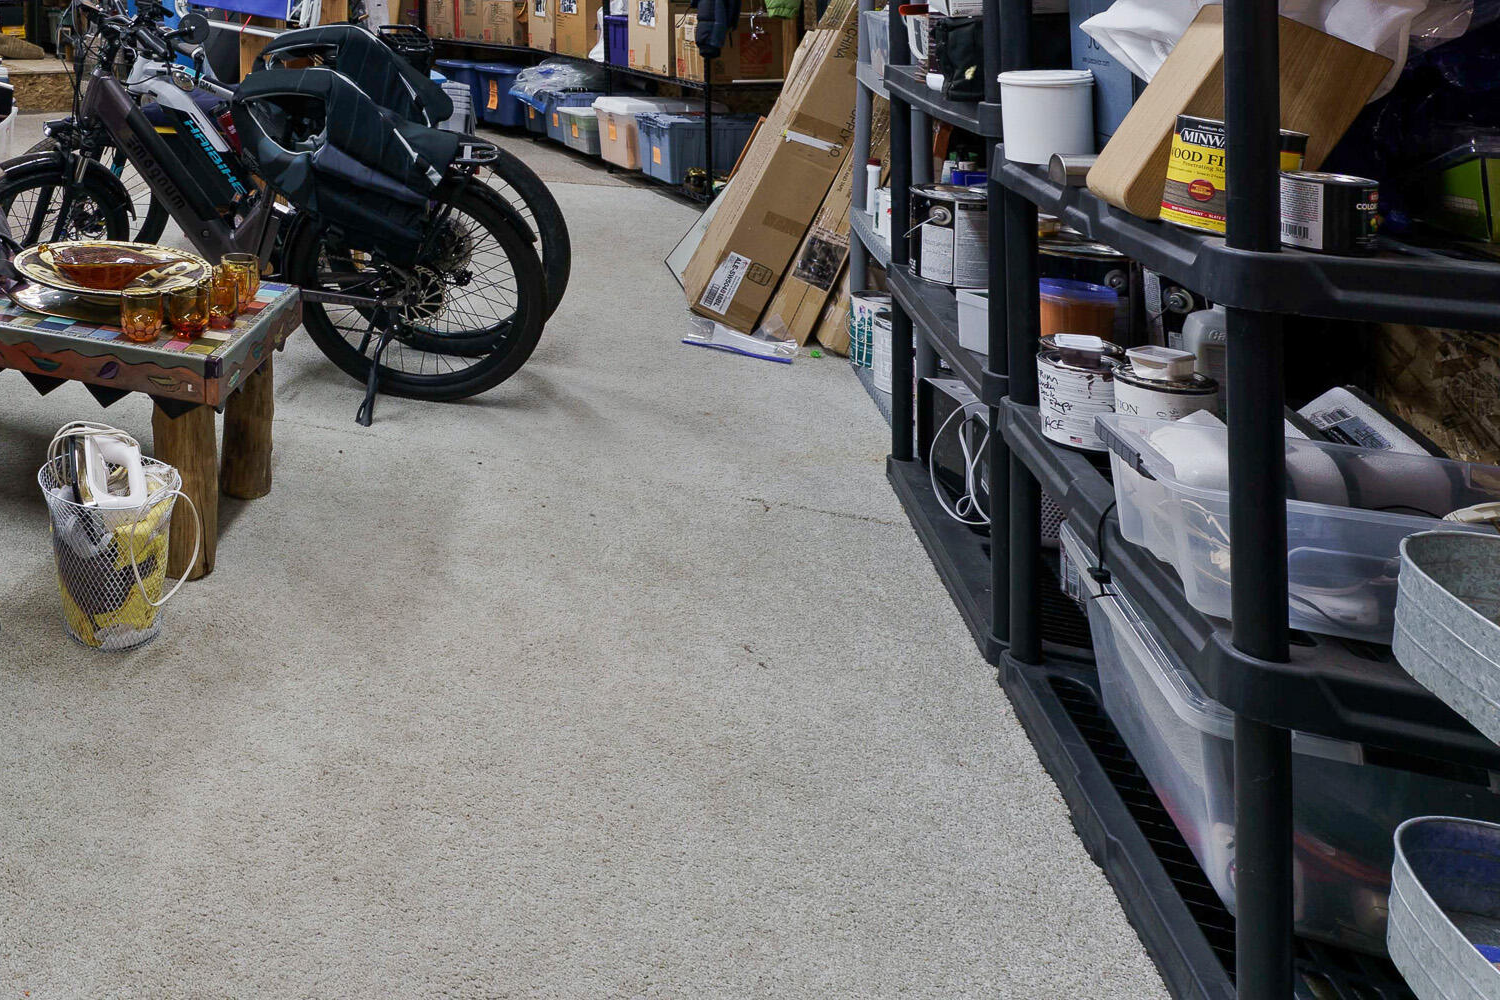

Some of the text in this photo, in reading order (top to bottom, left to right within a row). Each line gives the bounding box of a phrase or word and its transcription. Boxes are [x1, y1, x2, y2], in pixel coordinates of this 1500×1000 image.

[834, 26, 857, 59] CHINA
[839, 104, 856, 143] UPPLY
[183, 119, 248, 195] HAIBIKE
[1172, 147, 1203, 162] OOD
[1044, 415, 1066, 432] ACE
